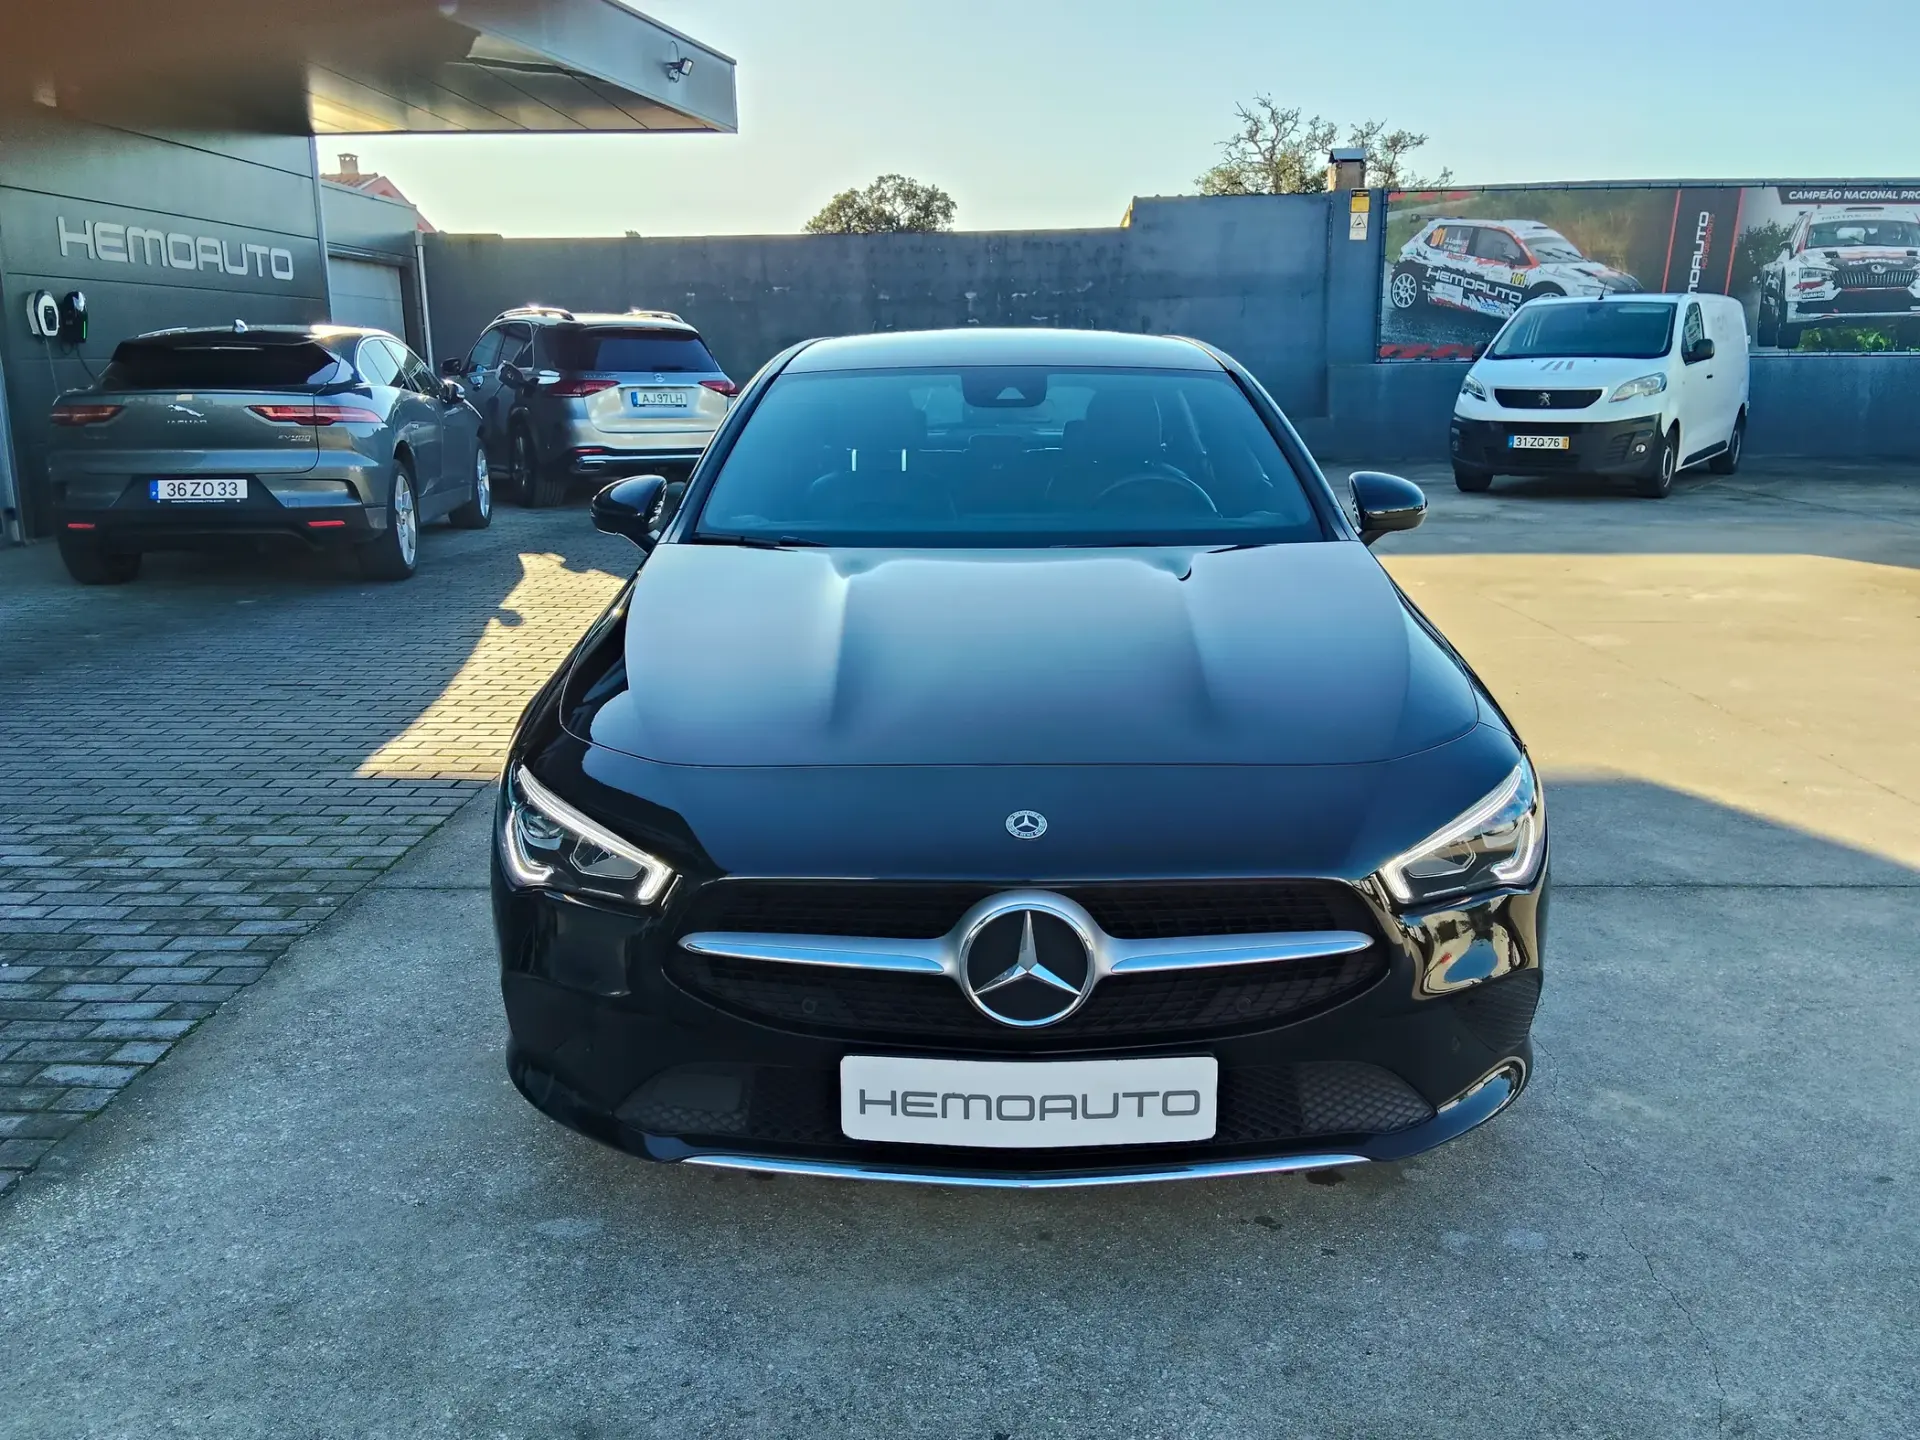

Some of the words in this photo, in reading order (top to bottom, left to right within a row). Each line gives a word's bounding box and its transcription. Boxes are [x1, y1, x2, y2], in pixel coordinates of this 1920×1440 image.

[1788, 189, 1842, 200] CAMPEÃO
[1843, 190, 1899, 200] NACIONAL
[57, 215, 295, 281] HEMOAUTO
[1426, 267, 1523, 304] HEMOAUTO
[1511, 272, 1525, 287] 101
[642, 391, 683, 404] AJ97LH
[859, 1088, 1201, 1122] HEMOAUTO
